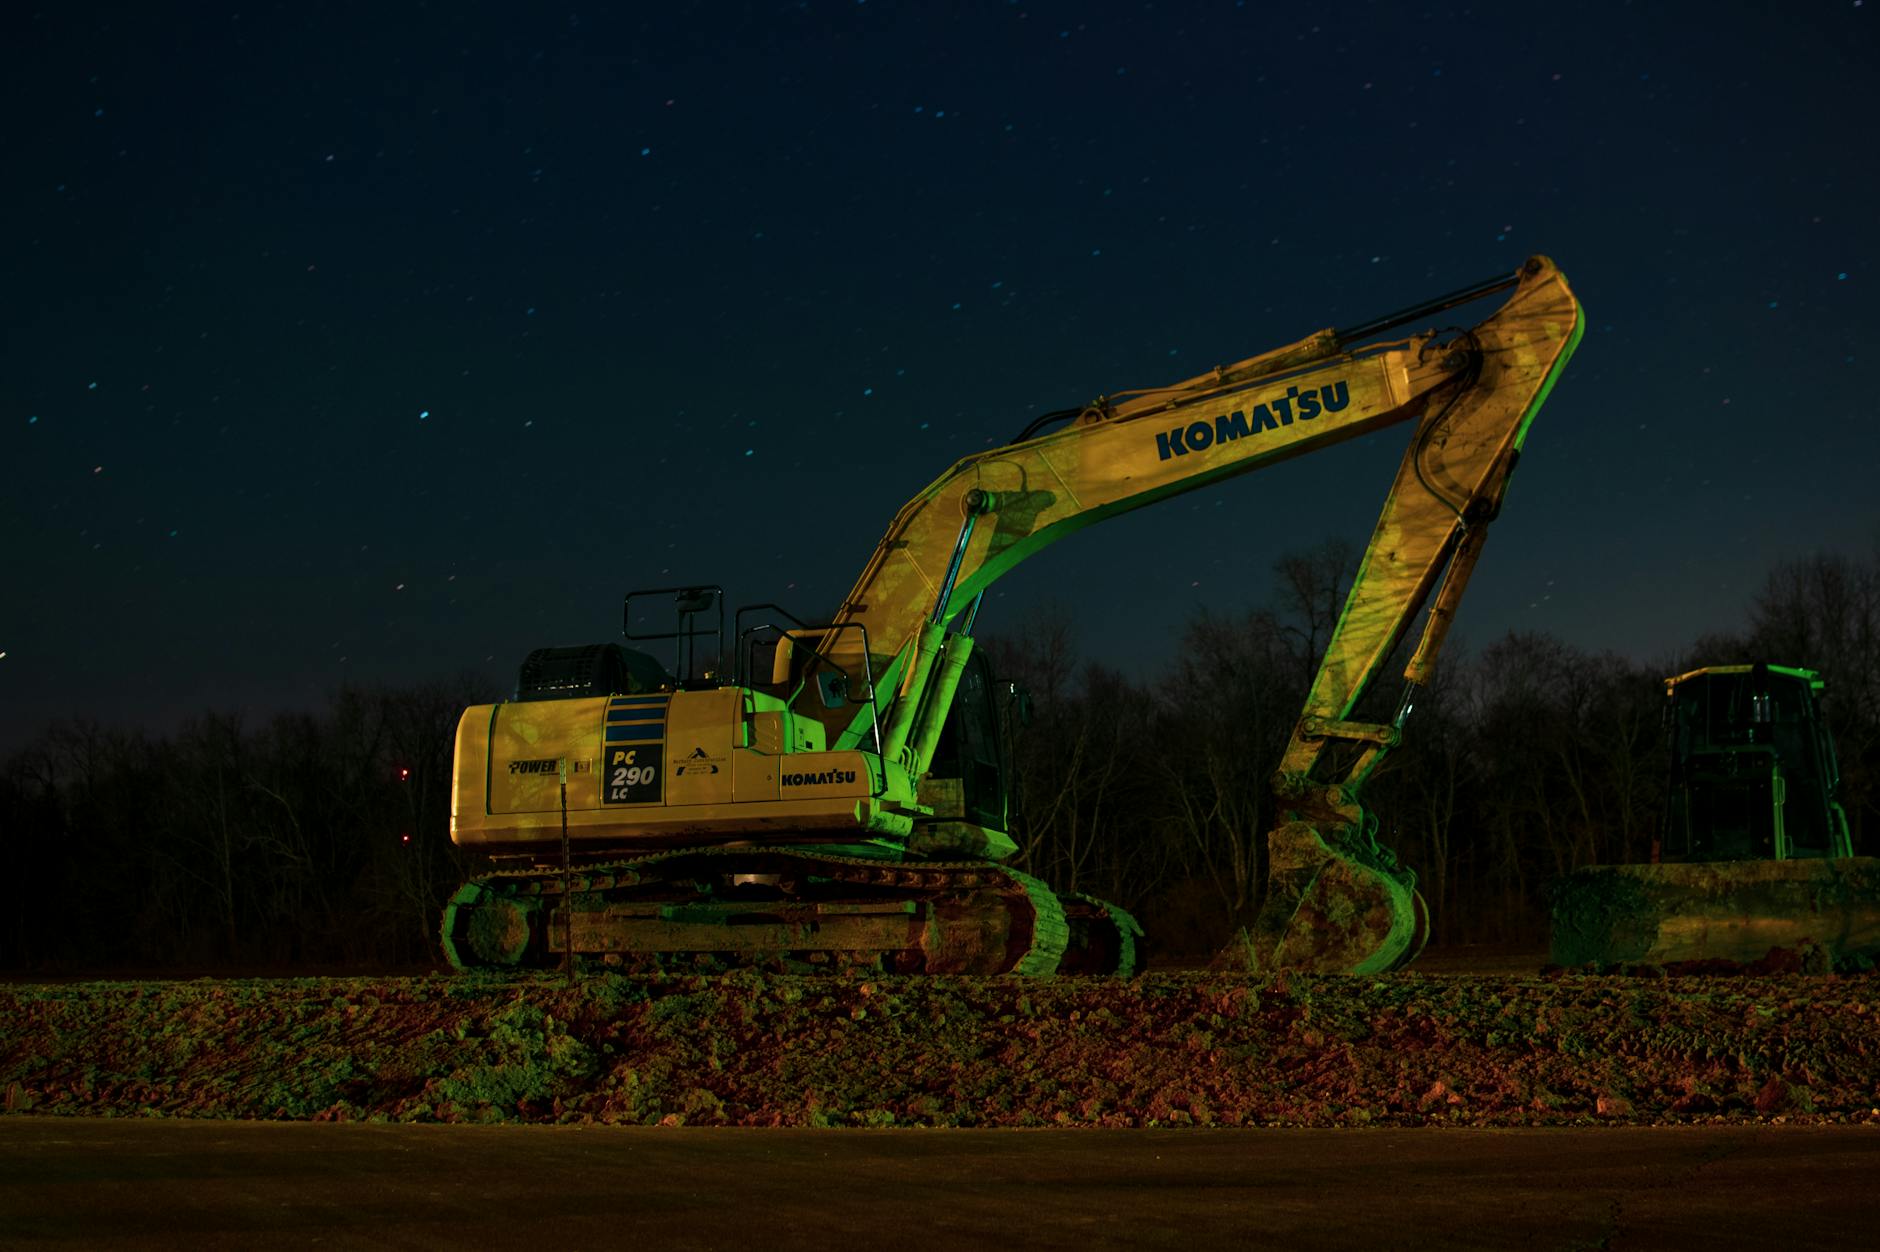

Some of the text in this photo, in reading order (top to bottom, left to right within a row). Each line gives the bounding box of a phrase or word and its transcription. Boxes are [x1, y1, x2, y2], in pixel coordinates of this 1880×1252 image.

[1156, 381, 1350, 461] KOMATSU
[612, 751, 637, 766] PC
[509, 760, 557, 774] POWER
[611, 766, 656, 786] 290
[782, 768, 856, 786] KOMATSU
[611, 787, 629, 800] LC
